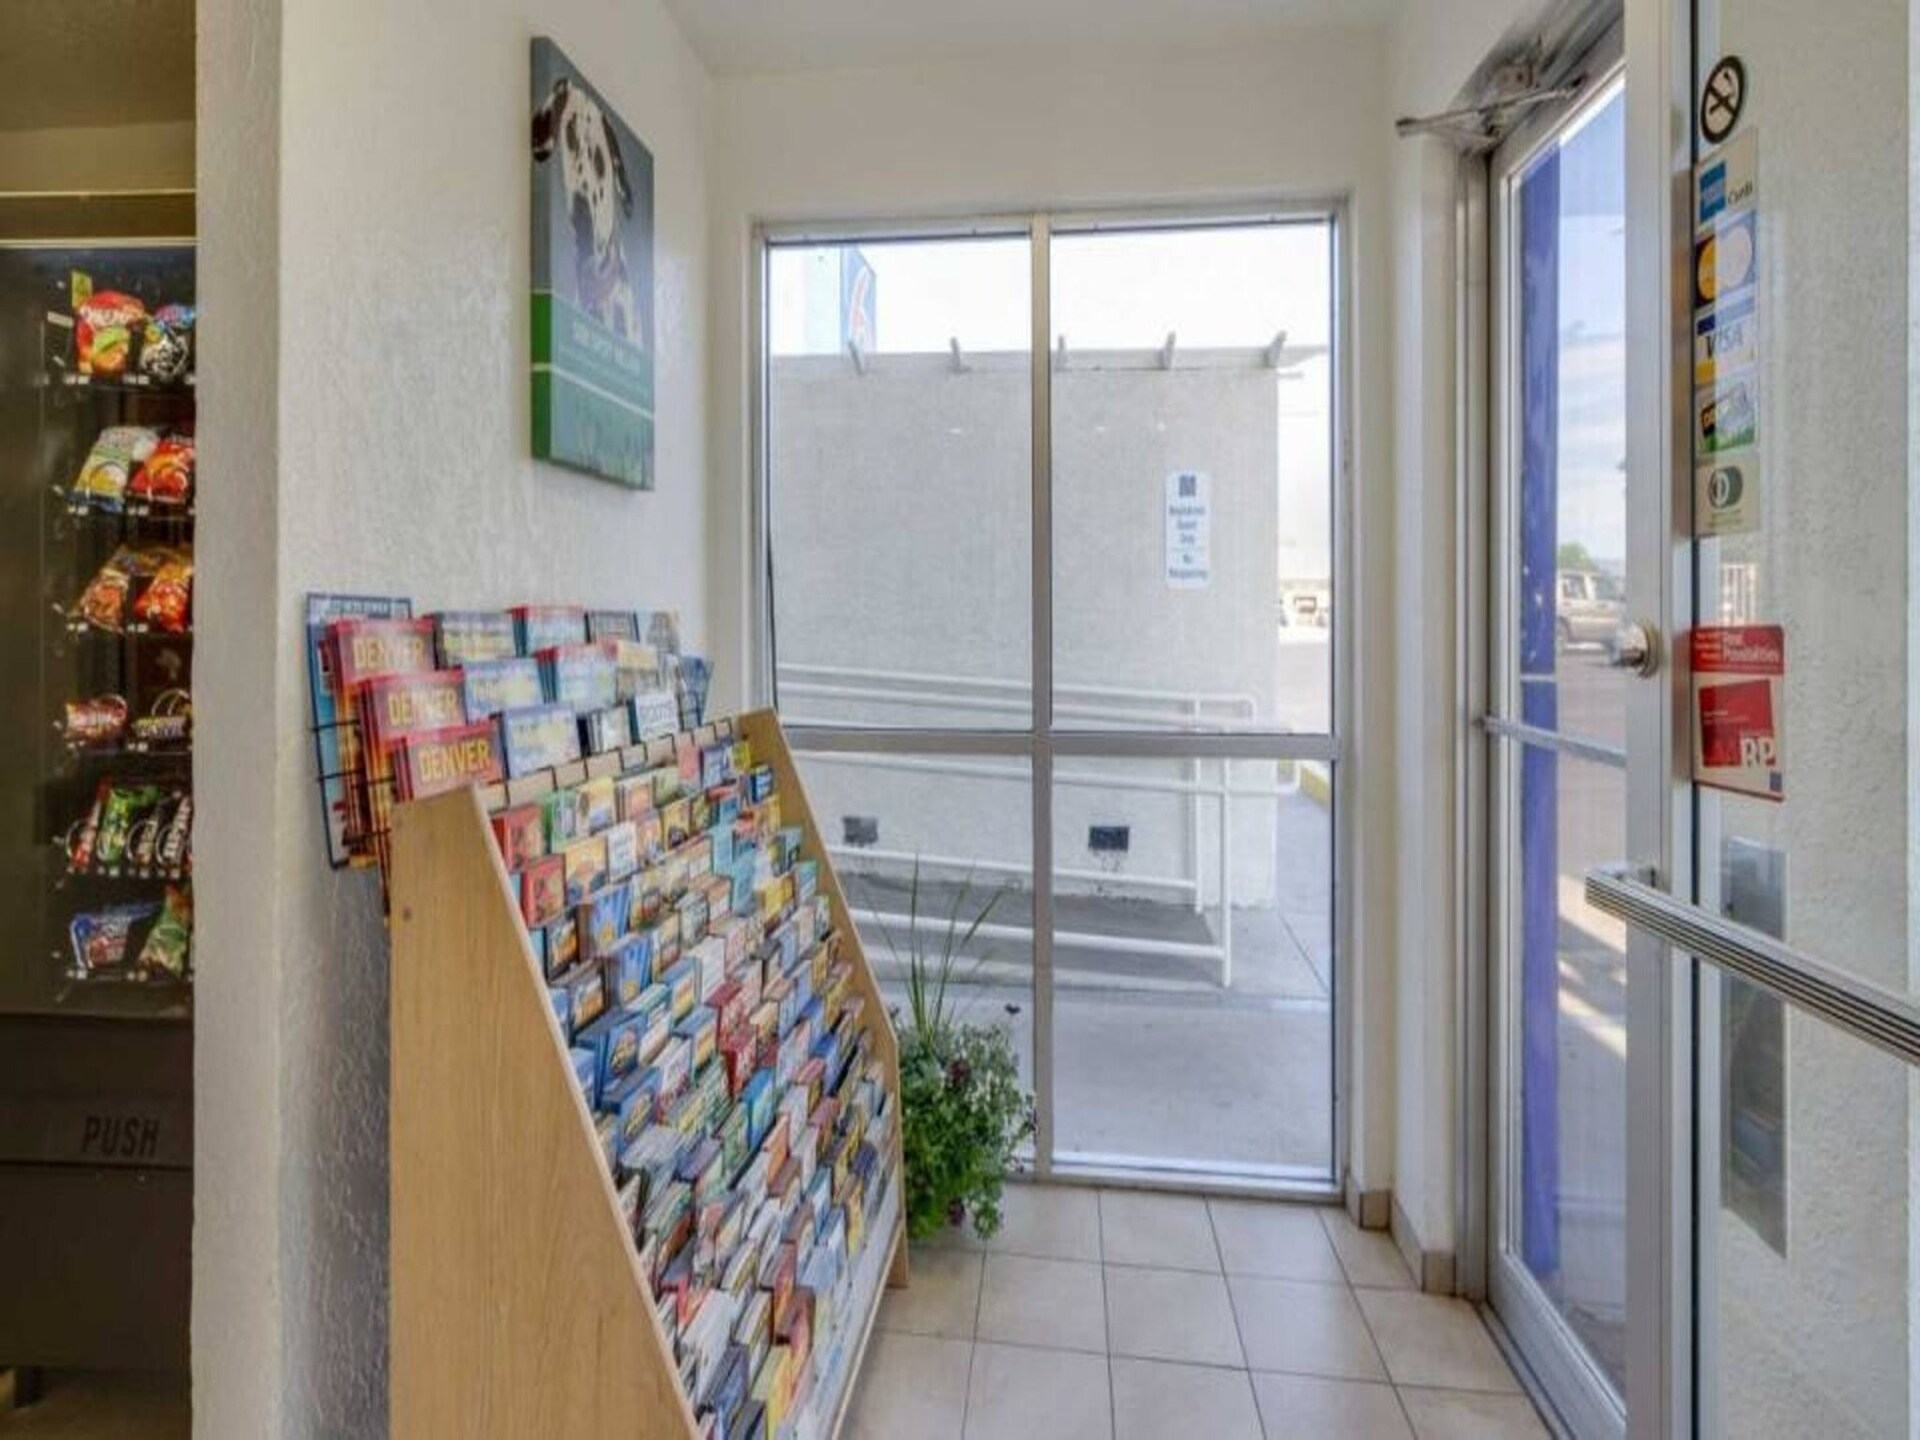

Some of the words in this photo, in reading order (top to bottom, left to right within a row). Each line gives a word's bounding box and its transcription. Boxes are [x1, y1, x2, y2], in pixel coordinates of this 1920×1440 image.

[1706, 321, 1744, 357] VISA
[352, 635, 425, 670] DENVER
[387, 686, 459, 727] DENVER
[418, 738, 490, 782] DENVER
[81, 1115, 160, 1157] PUSH
